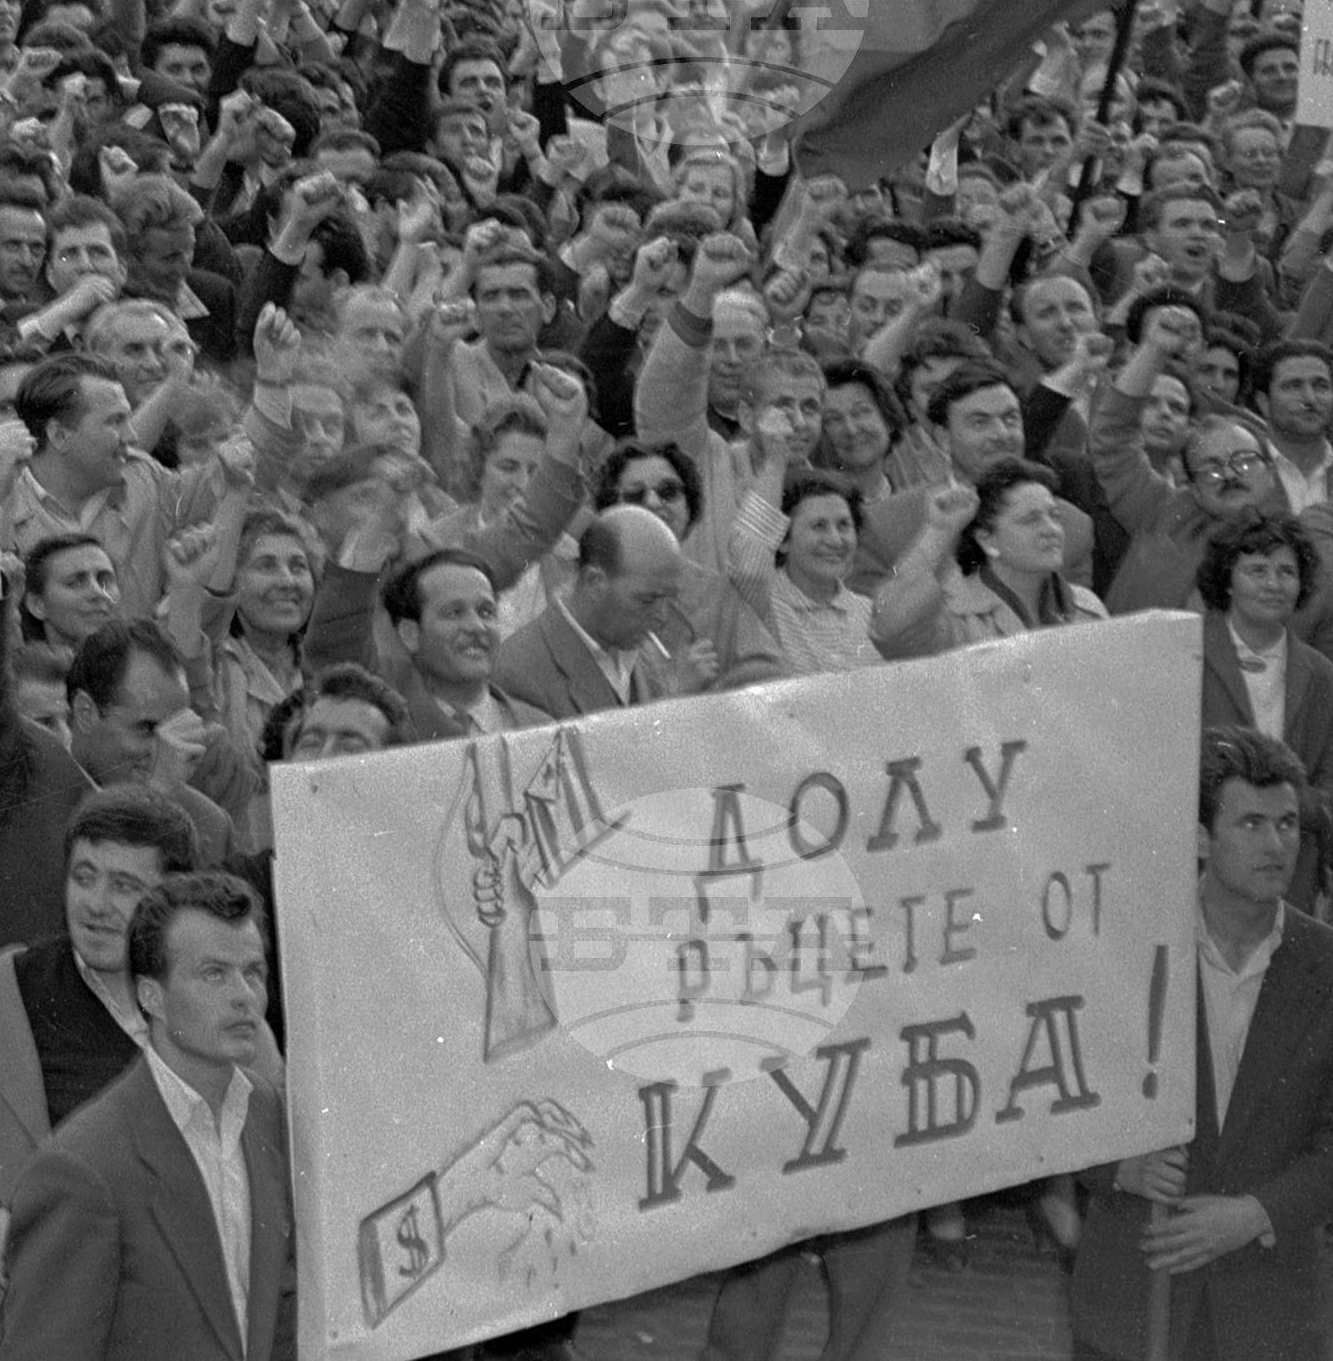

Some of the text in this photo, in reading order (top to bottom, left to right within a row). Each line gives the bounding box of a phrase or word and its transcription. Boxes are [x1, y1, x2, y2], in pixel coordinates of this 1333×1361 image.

[692, 740, 1028, 924] ДОЛУ
[674, 860, 1112, 1023] РЪЦЕТЕ ОТ
